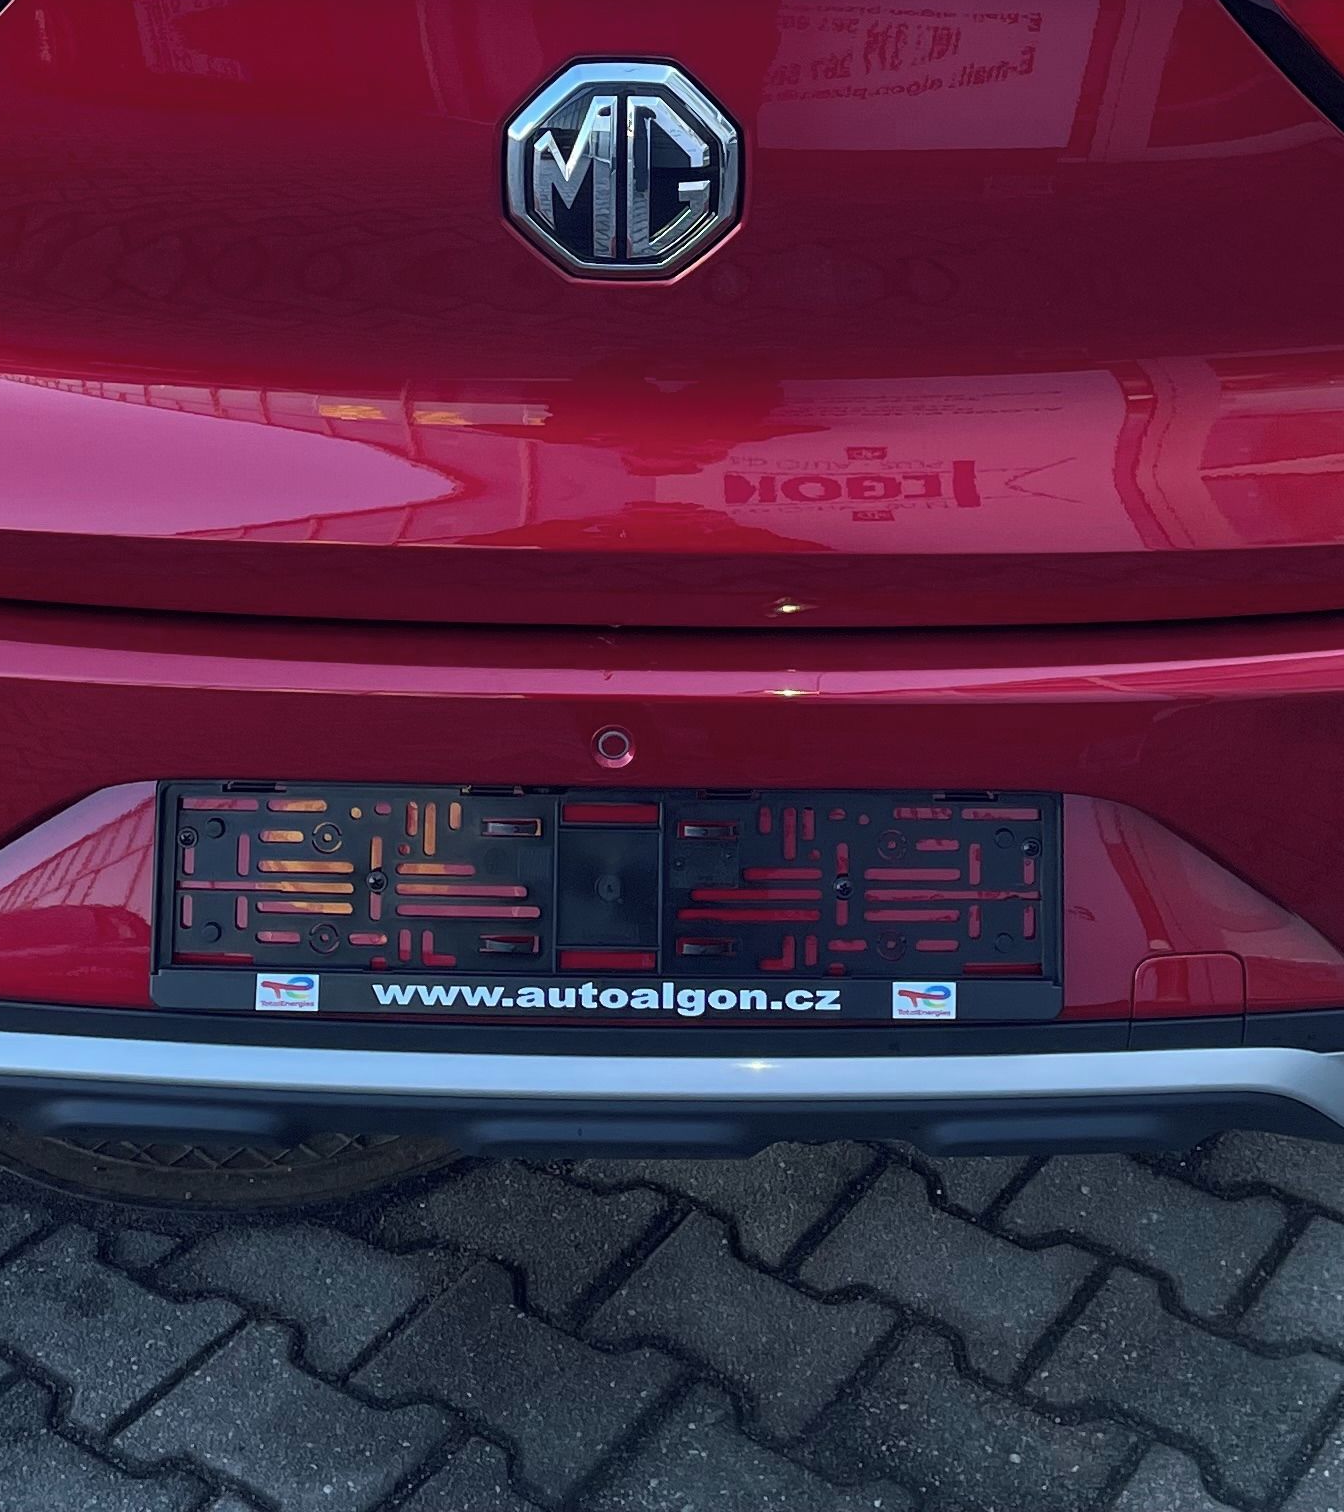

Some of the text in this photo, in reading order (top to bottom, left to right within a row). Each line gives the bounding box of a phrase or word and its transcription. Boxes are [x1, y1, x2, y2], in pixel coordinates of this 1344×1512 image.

[533, 94, 711, 259] MG
[260, 999, 315, 1009] TotalEnergies
[372, 982, 841, 1016] www.autoalgon.cz
[897, 1008, 951, 1018] TotalEnergies
